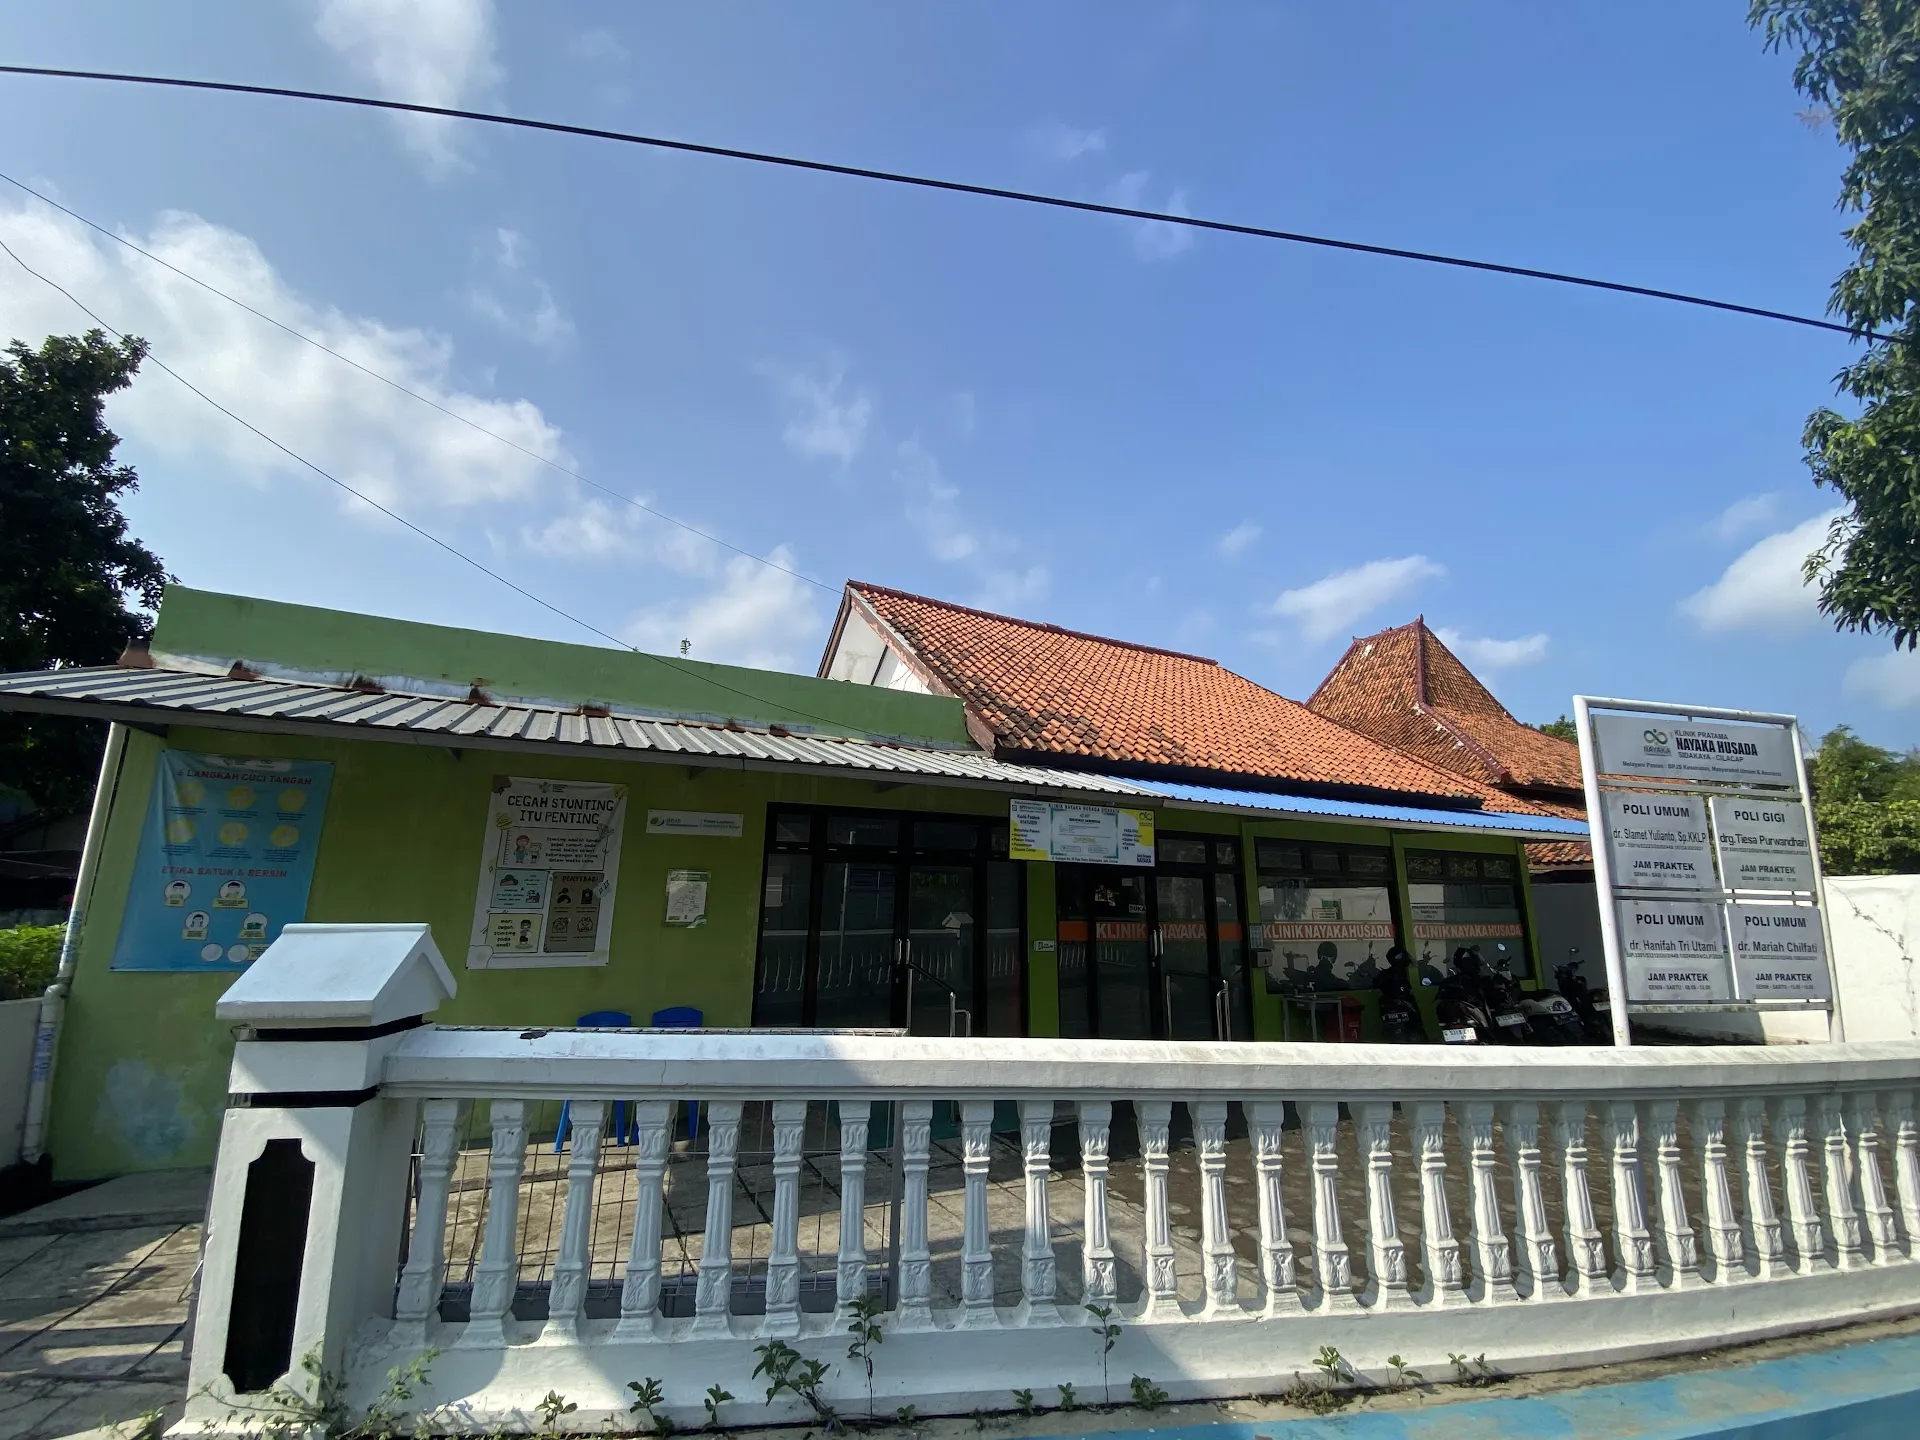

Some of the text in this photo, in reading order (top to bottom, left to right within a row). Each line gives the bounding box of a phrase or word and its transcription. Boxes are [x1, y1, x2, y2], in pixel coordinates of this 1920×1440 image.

[1698, 732, 1728, 740] PRATAMA
[1644, 746, 1672, 754] NAYAKA
[1676, 738, 1758, 756] NAYAKA HUSADA
[1678, 752, 1711, 760] SIDAKAYA
[1716, 754, 1744, 762] CILACAP
[187, 770, 240, 780] LANGKAH
[242, 773, 266, 782] CUCI
[270, 775, 312, 785] TANGAN
[508, 796, 614, 812] CEGAH STUNTING
[520, 810, 600, 824] ITU PENTING
[1623, 804, 1690, 818] POLI UMUM
[1734, 810, 1786, 822] POLI GIGI
[1613, 828, 1622, 839] dr.
[1624, 828, 1648, 840] Slamet
[1760, 835, 1808, 848] Purwandhari
[1633, 860, 1695, 870] JAM PRAKTEK
[1740, 864, 1796, 874] JAM PRAKTEK
[162, 866, 194, 875] ETIKA
[197, 866, 235, 876] BATUK
[247, 868, 288, 878] BERSIN
[1636, 914, 1704, 926] POLI UMUM
[1744, 916, 1807, 928] POLI UMUM
[1096, 922, 1207, 939] KLINIK NAYAKA
[1263, 924, 1392, 938] KLINIK NAYAKA HUSADA
[1414, 924, 1522, 938] KLINIK NAYAKA HUSADA
[1630, 940, 1718, 952] dr. Hanifah Tri Utami
[1738, 941, 1818, 953] dr. Mariah Chilfati
[1648, 972, 1709, 982] JAM PRAKTEK
[1755, 973, 1812, 982] JAM PRAKTEK
